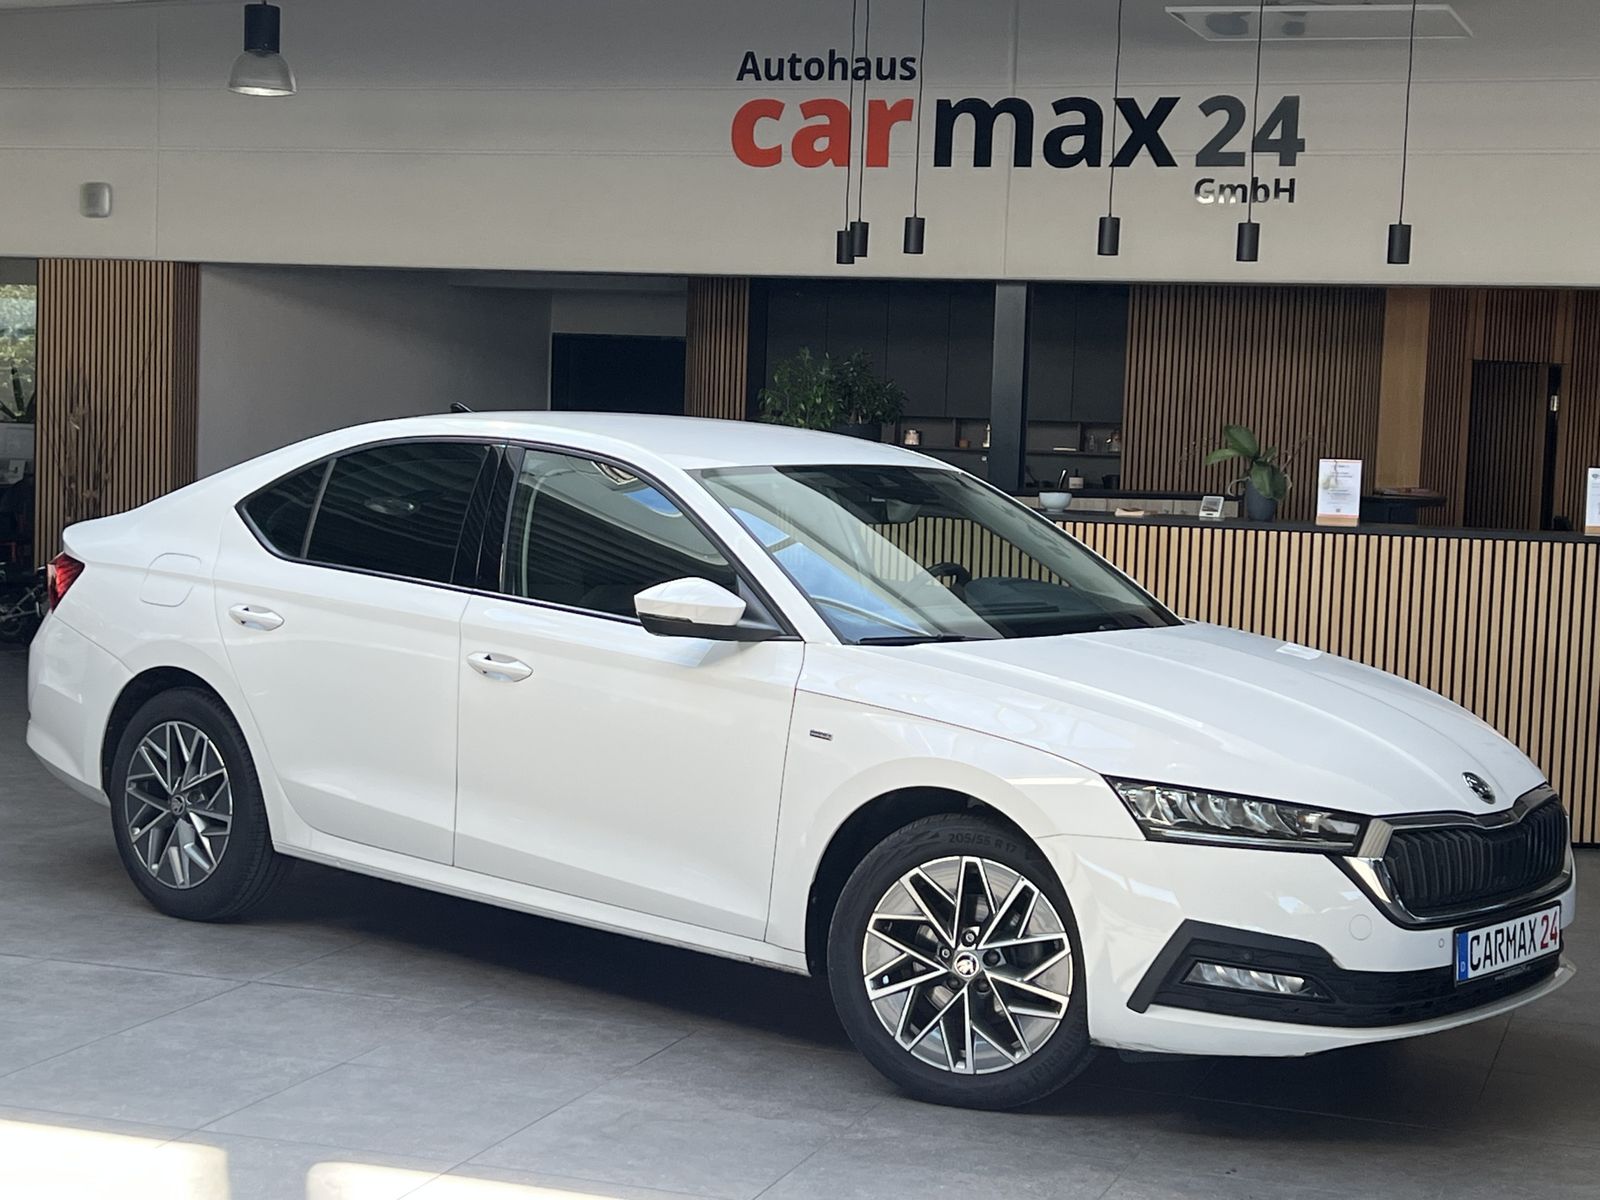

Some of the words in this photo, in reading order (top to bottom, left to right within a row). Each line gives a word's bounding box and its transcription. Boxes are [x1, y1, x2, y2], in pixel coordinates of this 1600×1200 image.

[736, 50, 917, 82] Autohaus
[1194, 95, 1306, 168] 24
[1193, 176, 1296, 204] GmbH
[948, 833, 991, 846] 205/55
[1469, 918, 1538, 972] CARMAX
[1540, 911, 1558, 950] 24
[1460, 962, 1466, 973] D
